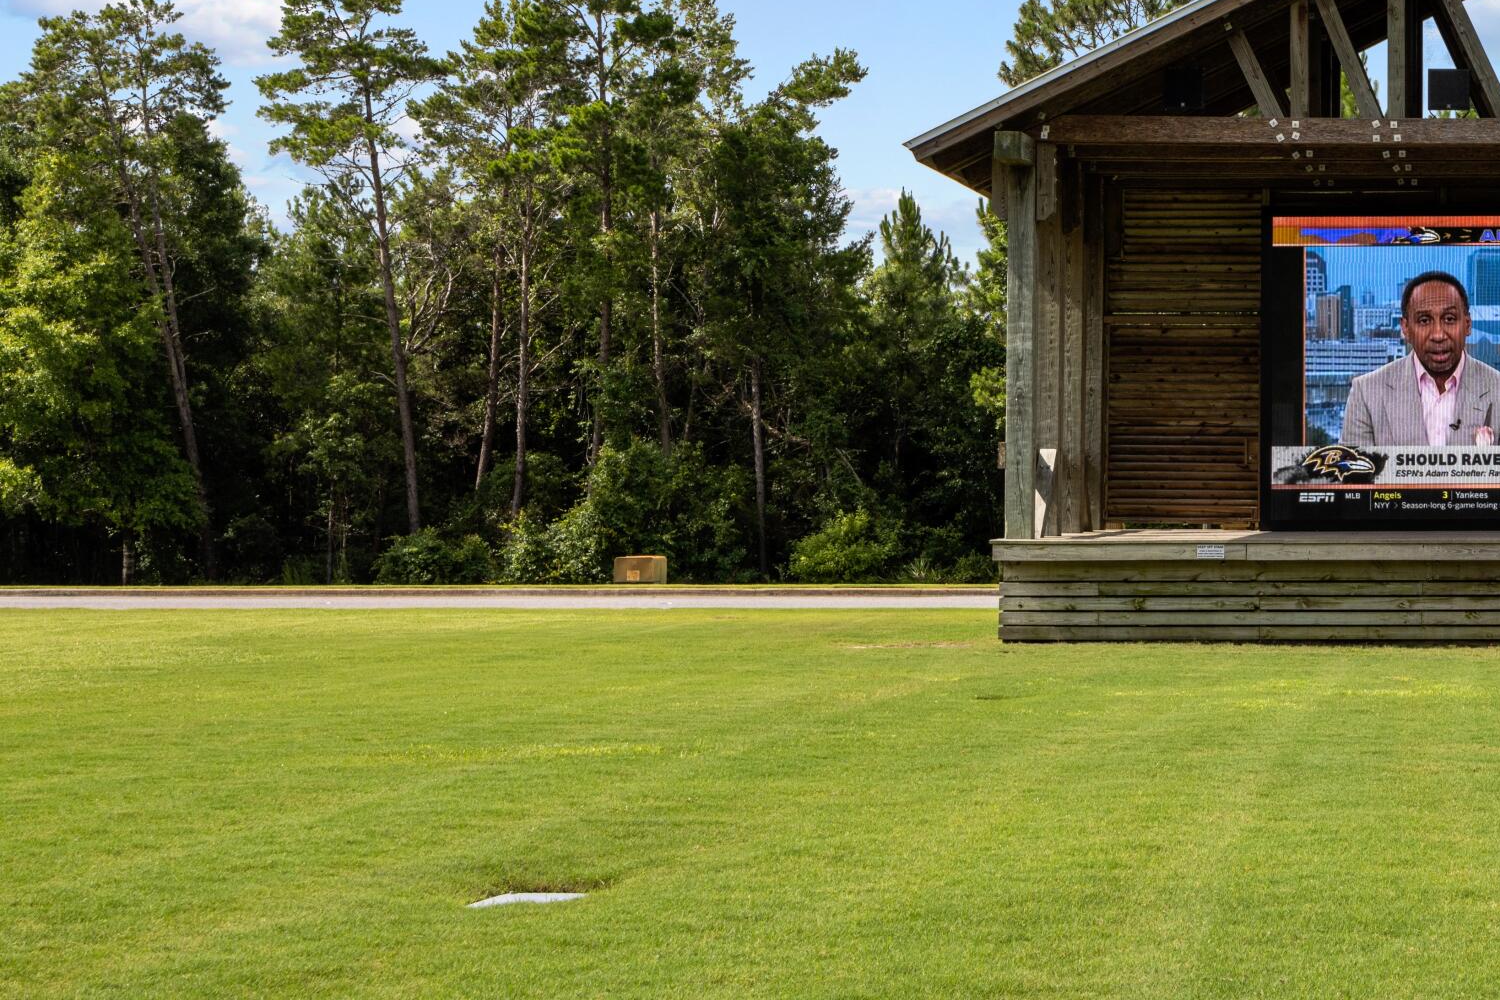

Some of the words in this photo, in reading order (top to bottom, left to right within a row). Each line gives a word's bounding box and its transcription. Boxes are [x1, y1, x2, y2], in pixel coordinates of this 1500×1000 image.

[1396, 453, 1457, 466] SHOULD
[1395, 469, 1424, 478] ESPN's
[1425, 469, 1449, 478] Adam
[1299, 492, 1335, 503] ESPN
[1373, 491, 1402, 501] Angels
[1441, 491, 1449, 499] 3
[1455, 491, 1489, 499] Yankees
[1401, 501, 1446, 510] Season-long
[1447, 501, 1475, 510] 6-game
[1476, 501, 1498, 510] losing
